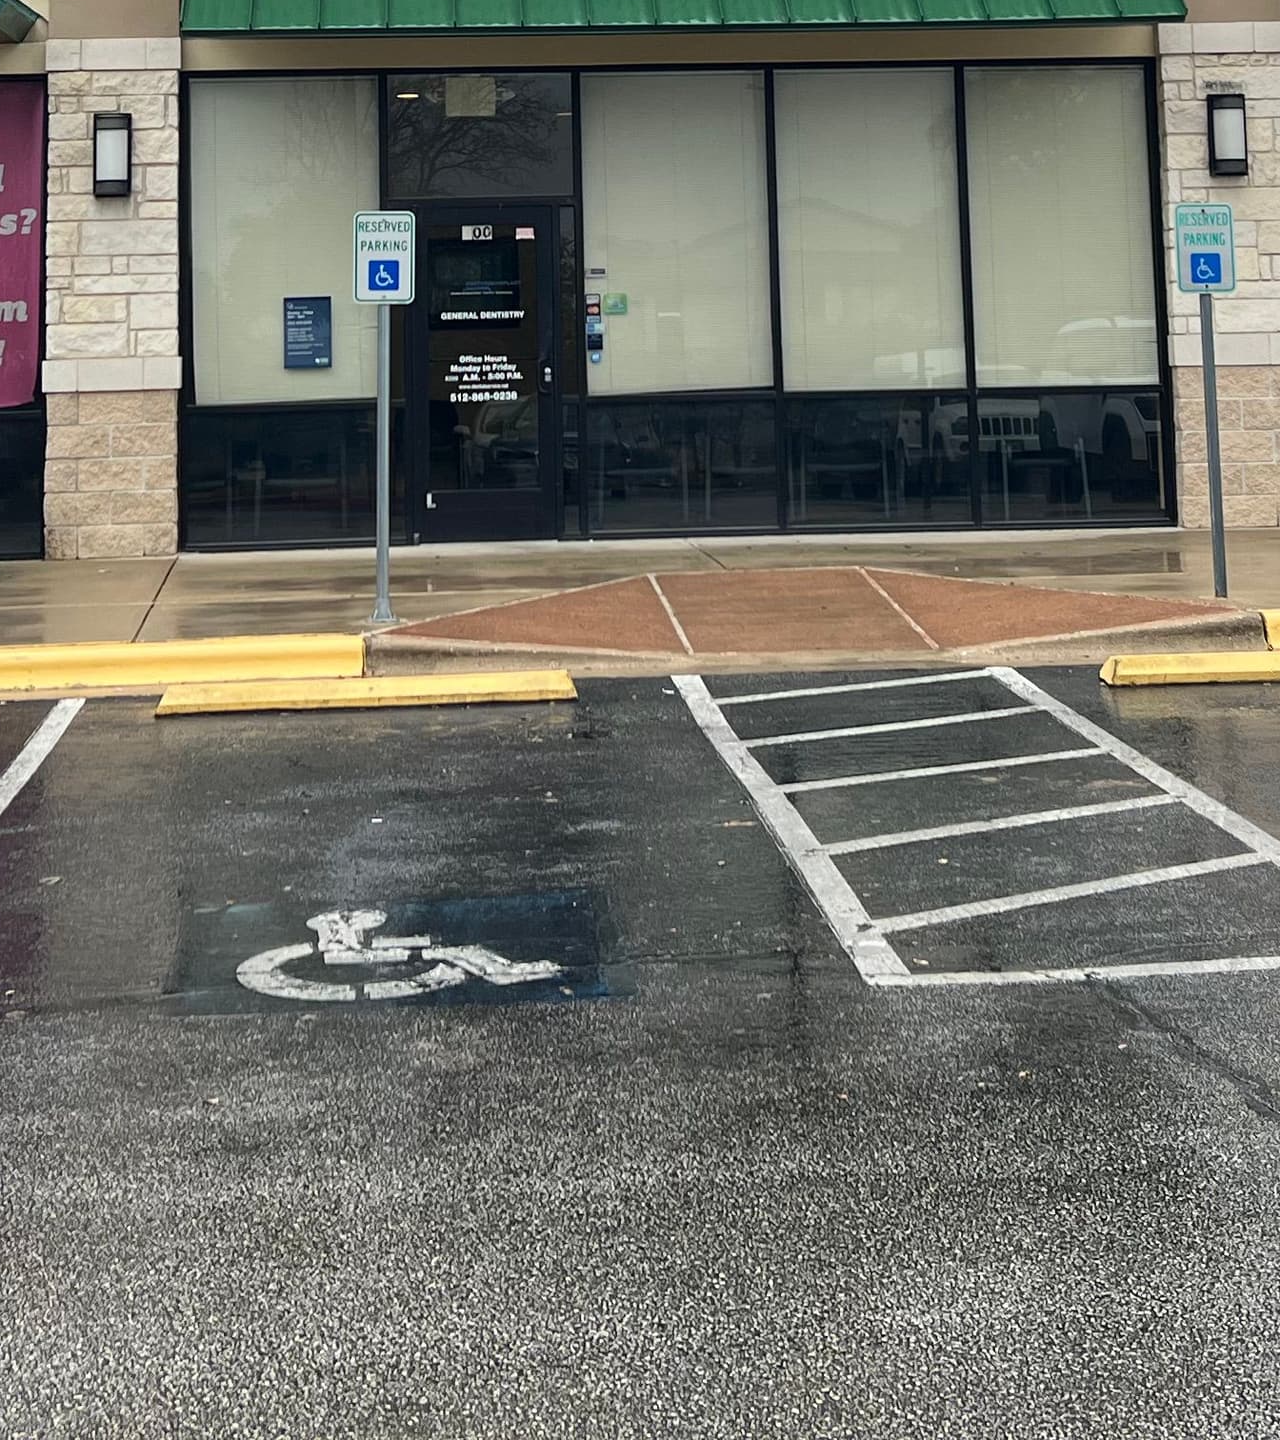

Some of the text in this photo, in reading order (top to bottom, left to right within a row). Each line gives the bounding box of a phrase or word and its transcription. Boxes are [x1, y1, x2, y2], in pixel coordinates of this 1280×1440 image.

[1178, 212, 1228, 226] RESERVED
[358, 221, 410, 233] RESERVED
[1184, 232, 1226, 247] PARKING
[360, 240, 408, 252] PARKING
[440, 310, 524, 320] GENERAL DENTISTRY
[459, 354, 507, 363] Office Hours
[450, 363, 517, 373] Monday to Friday
